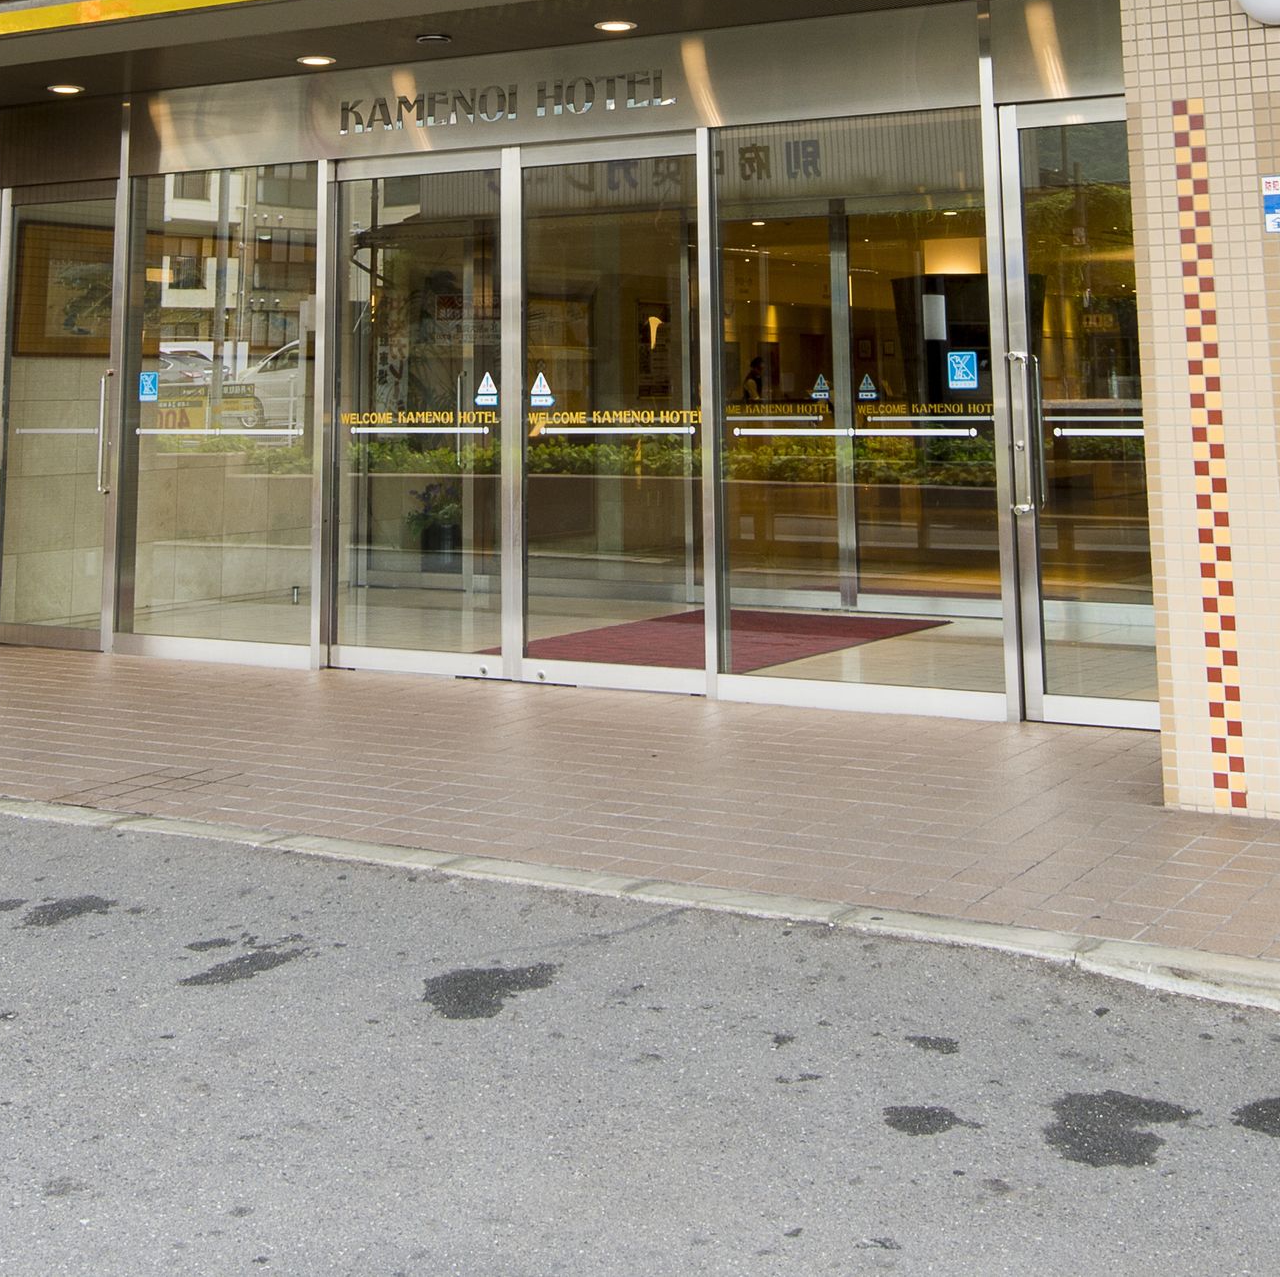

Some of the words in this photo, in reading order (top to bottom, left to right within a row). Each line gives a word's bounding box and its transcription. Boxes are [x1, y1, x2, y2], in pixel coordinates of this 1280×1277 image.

[339, 84, 518, 135] KAMENOI
[536, 70, 677, 117] HOTEL
[858, 405, 907, 415] WELCOME
[911, 403, 964, 414] KAMENOI
[968, 403, 994, 414] HOT
[341, 412, 393, 424] WELCOME
[398, 410, 454, 424] KAMENOI
[458, 410, 500, 424] HOTEL
[528, 411, 587, 424] WELCOME
[592, 410, 655, 424] KAMENOI
